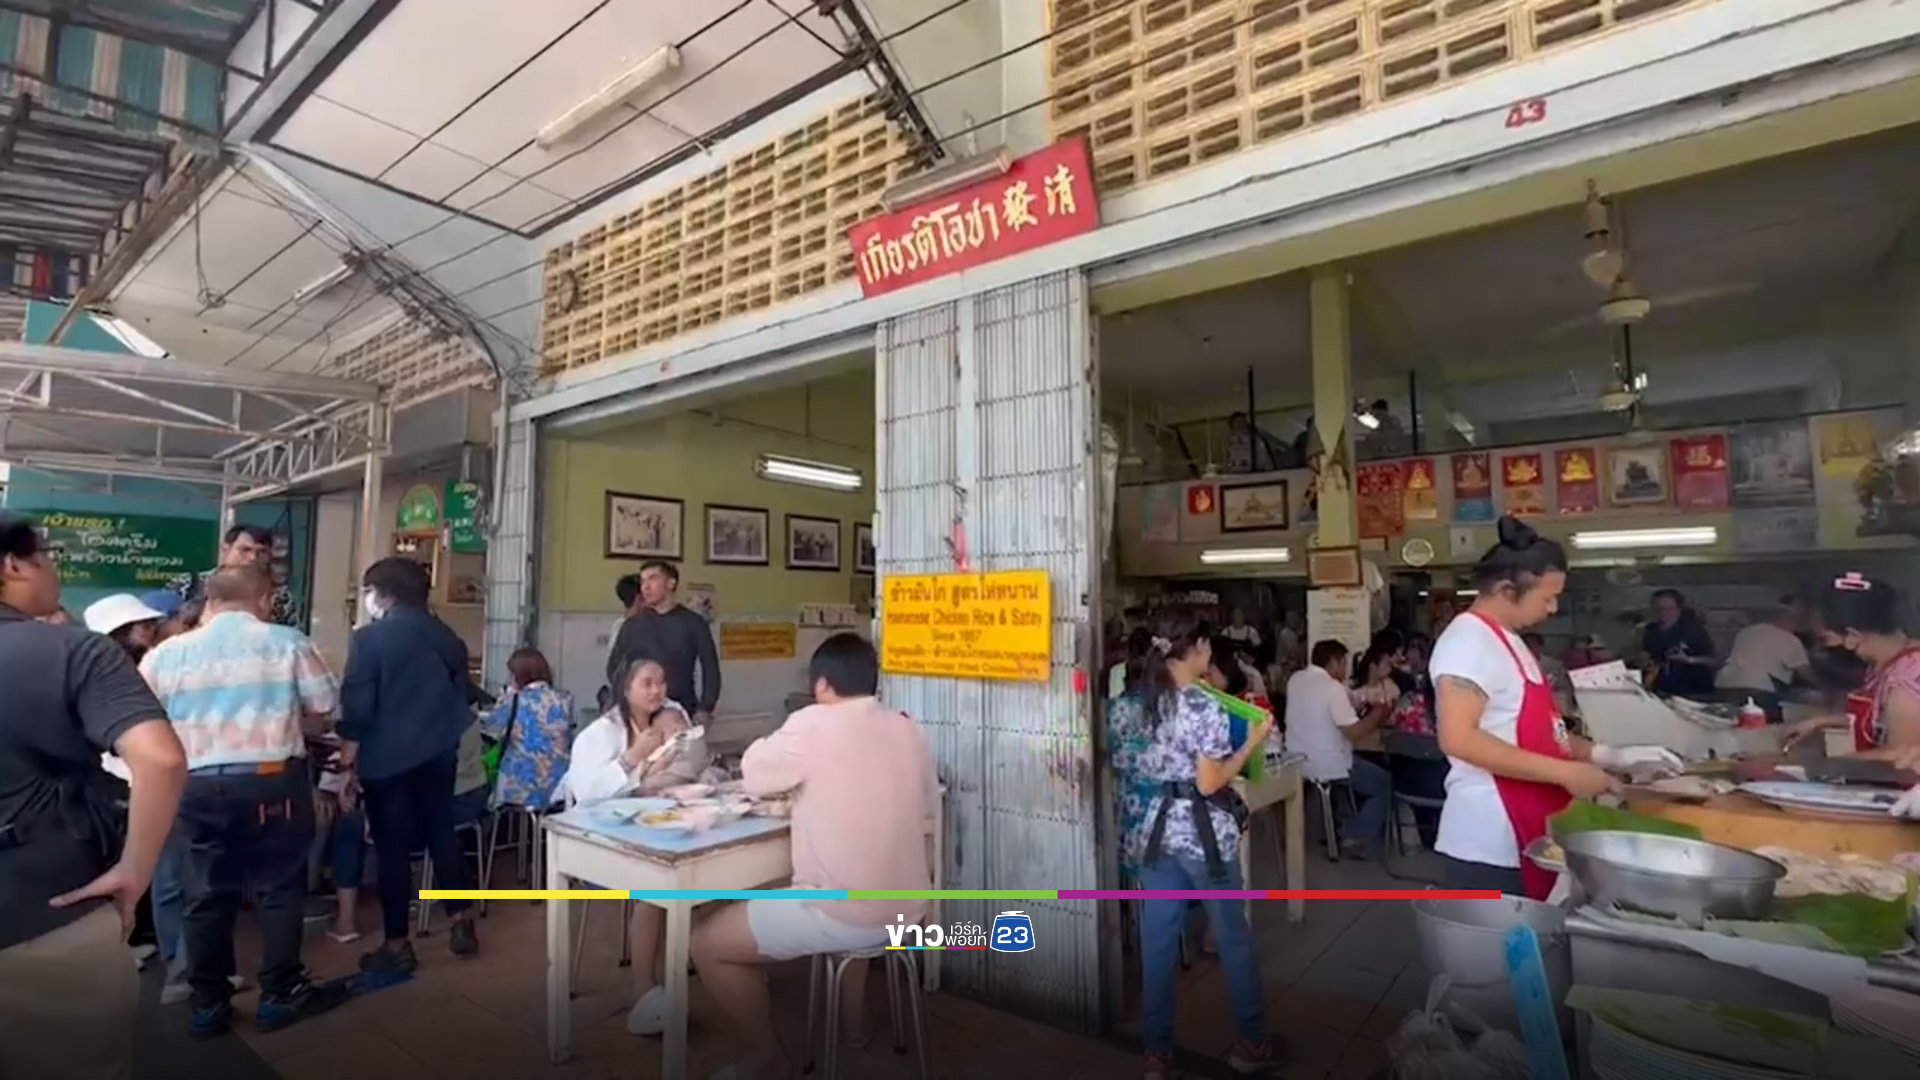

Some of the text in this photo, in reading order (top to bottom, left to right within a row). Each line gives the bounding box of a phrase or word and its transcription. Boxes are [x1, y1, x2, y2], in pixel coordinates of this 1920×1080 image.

[1505, 99, 1547, 128] 43
[861, 197, 1000, 285] เกียรติโอชา
[889, 576, 947, 602] ข้าวมันไก่
[972, 608, 995, 626] Rice
[998, 608, 1007, 626] &
[1010, 607, 1043, 629] Satay
[931, 628, 956, 642] Since
